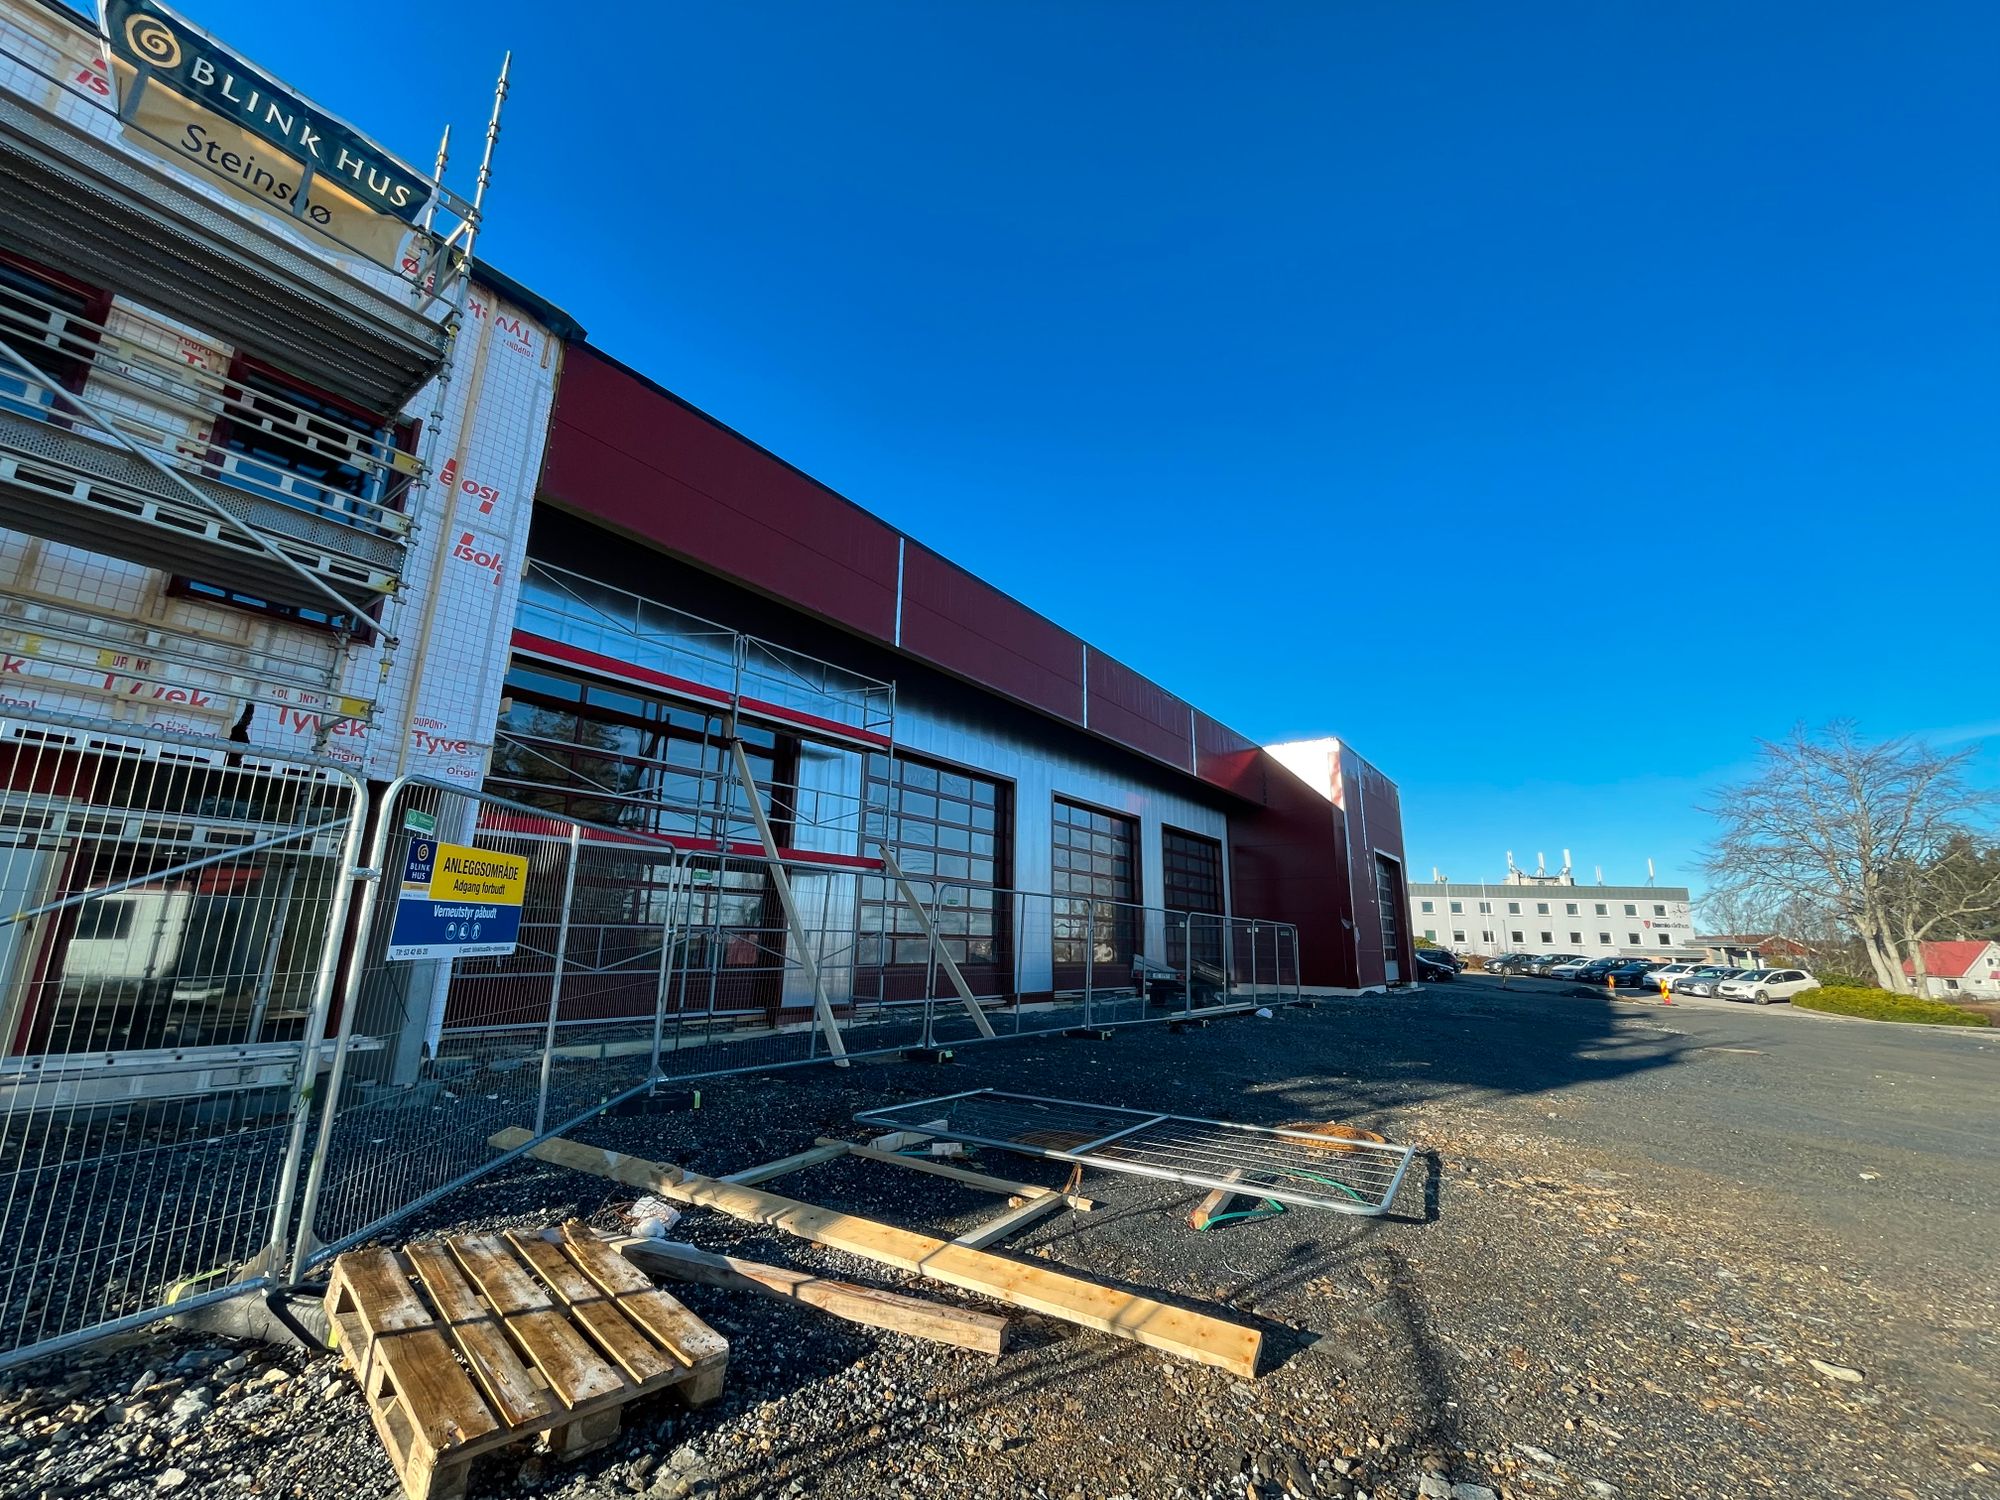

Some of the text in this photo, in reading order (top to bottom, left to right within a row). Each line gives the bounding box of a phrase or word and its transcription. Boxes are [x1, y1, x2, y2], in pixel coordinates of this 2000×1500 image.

[191, 56, 412, 208] BLINK HUS
[439, 458, 500, 515] isoa
[413, 717, 443, 730] DUPONT
[411, 729, 478, 755] Tyve
[327, 749, 377, 765] riginl
[409, 862, 431, 872] BLINK
[443, 856, 520, 881] ANLEGGSOMRÅDE
[411, 871, 426, 880] HUS
[453, 878, 506, 895] Adgang forbudt
[433, 904, 497, 920] Verneutstyr påbudt
